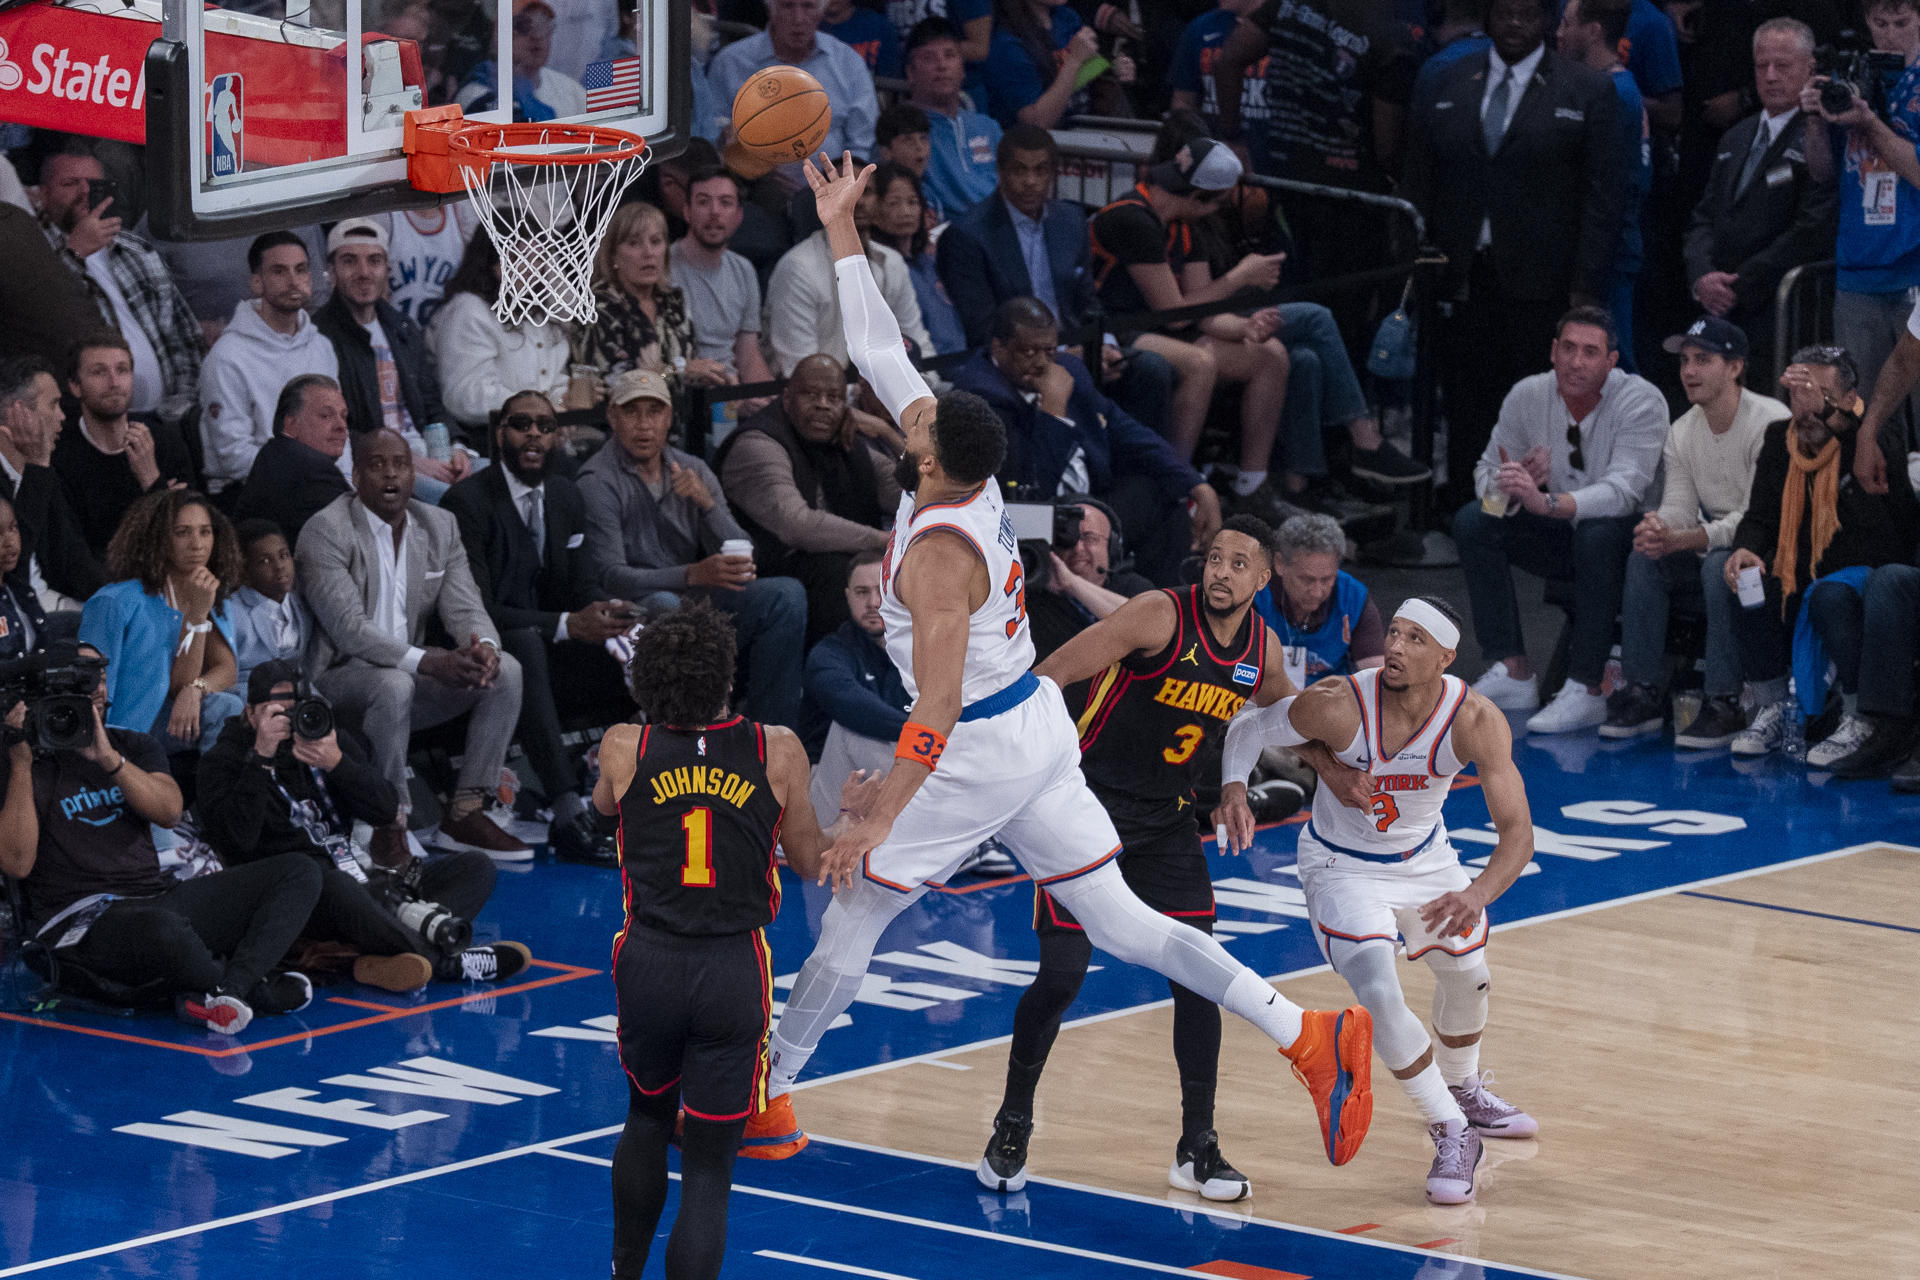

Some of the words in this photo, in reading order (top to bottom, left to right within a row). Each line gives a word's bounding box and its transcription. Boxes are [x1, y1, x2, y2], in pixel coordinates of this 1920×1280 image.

[26, 42, 132, 108] State
[216, 154, 232, 172] NBA
[1235, 668, 1256, 680] paze
[1153, 677, 1247, 722] HAWKS
[1162, 723, 1205, 766] 3
[60, 786, 124, 821] prime
[650, 765, 756, 809] JOHNSON
[1369, 791, 1401, 833] 3
[681, 806, 716, 889] 1
[111, 1055, 562, 1160] NEW
